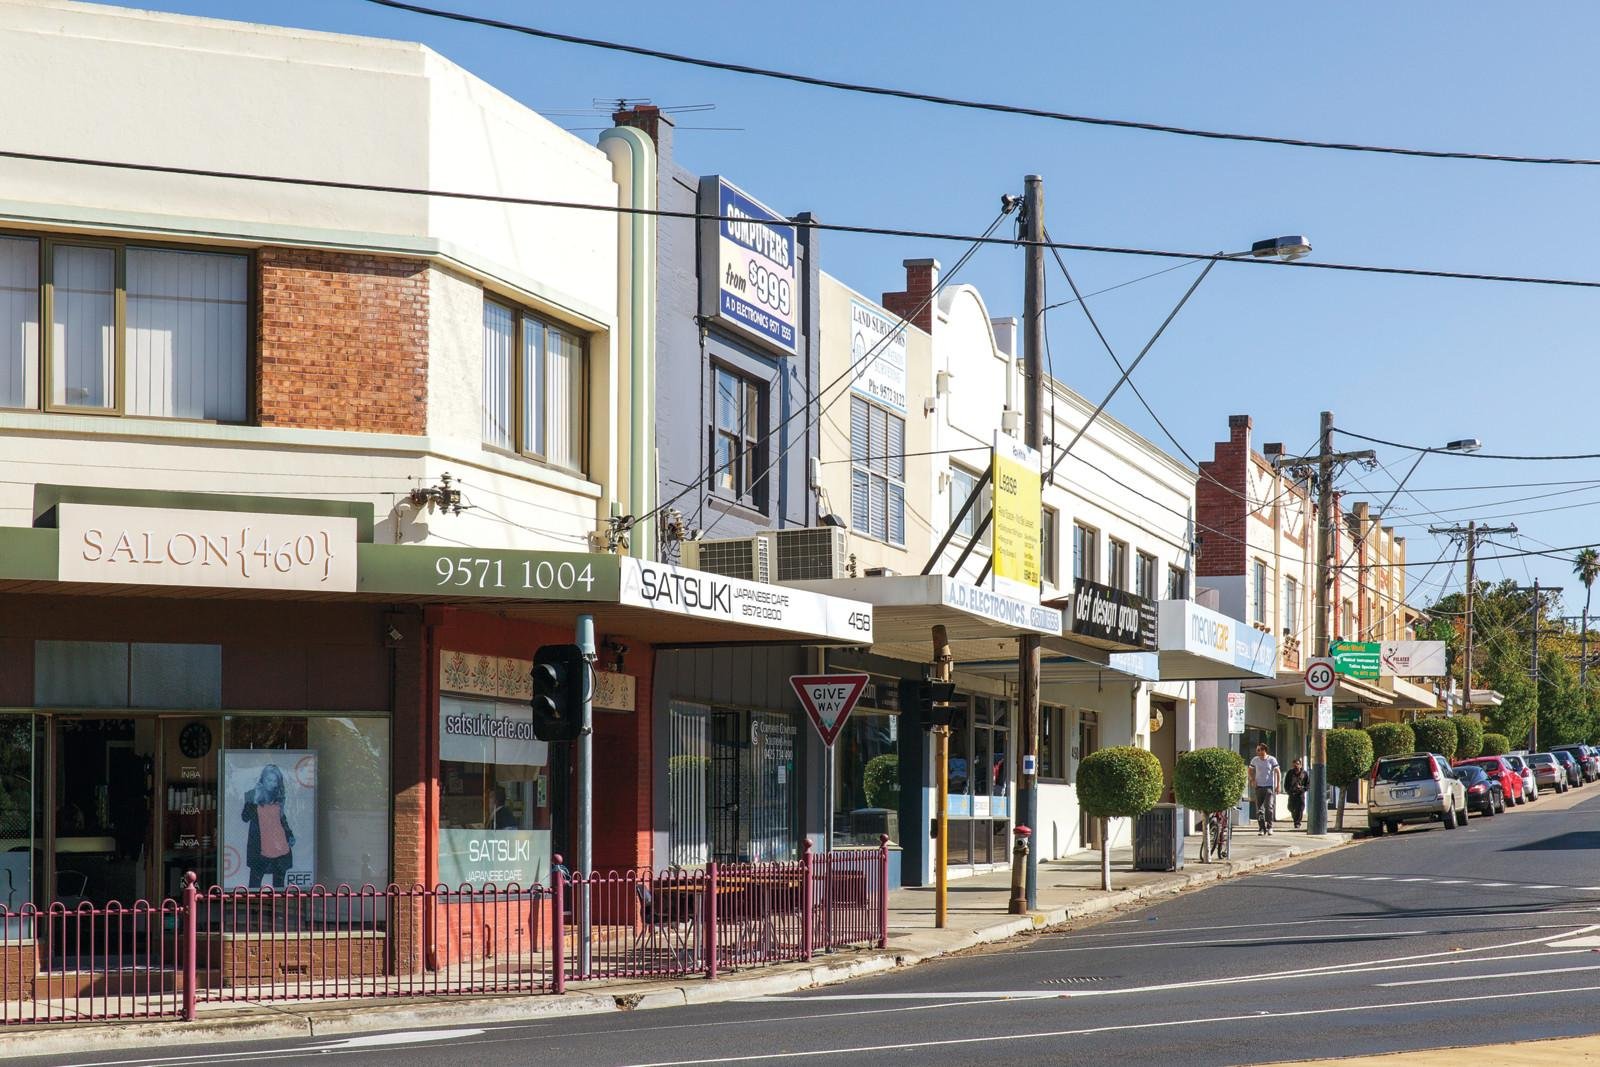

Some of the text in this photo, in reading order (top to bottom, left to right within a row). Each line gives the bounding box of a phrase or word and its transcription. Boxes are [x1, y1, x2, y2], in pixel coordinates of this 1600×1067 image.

[726, 203, 789, 268] COMPUTERS
[725, 259, 790, 316] from $999
[725, 296, 731, 309] A
[736, 301, 769, 329] ELECTRONICS
[853, 306, 871, 328] LAND
[999, 464, 1017, 496] Lease
[435, 556, 596, 592] 9571 1004
[641, 568, 732, 614] SATSUKI
[733, 587, 790, 608] JAPANESE CAFE
[742, 604, 782, 621] 9572 0200
[948, 582, 1025, 626] A.D. ELECTRONICS
[1076, 586, 1092, 621] dcf
[1092, 590, 1117, 634] design
[1117, 604, 1139, 640] group
[848, 611, 871, 632] 458
[1310, 670, 1330, 683] 60
[813, 688, 846, 700] GIVE
[818, 702, 840, 711] WAY
[469, 839, 530, 862] SATSUKI
[465, 869, 522, 882] JAPANESE CAFE
